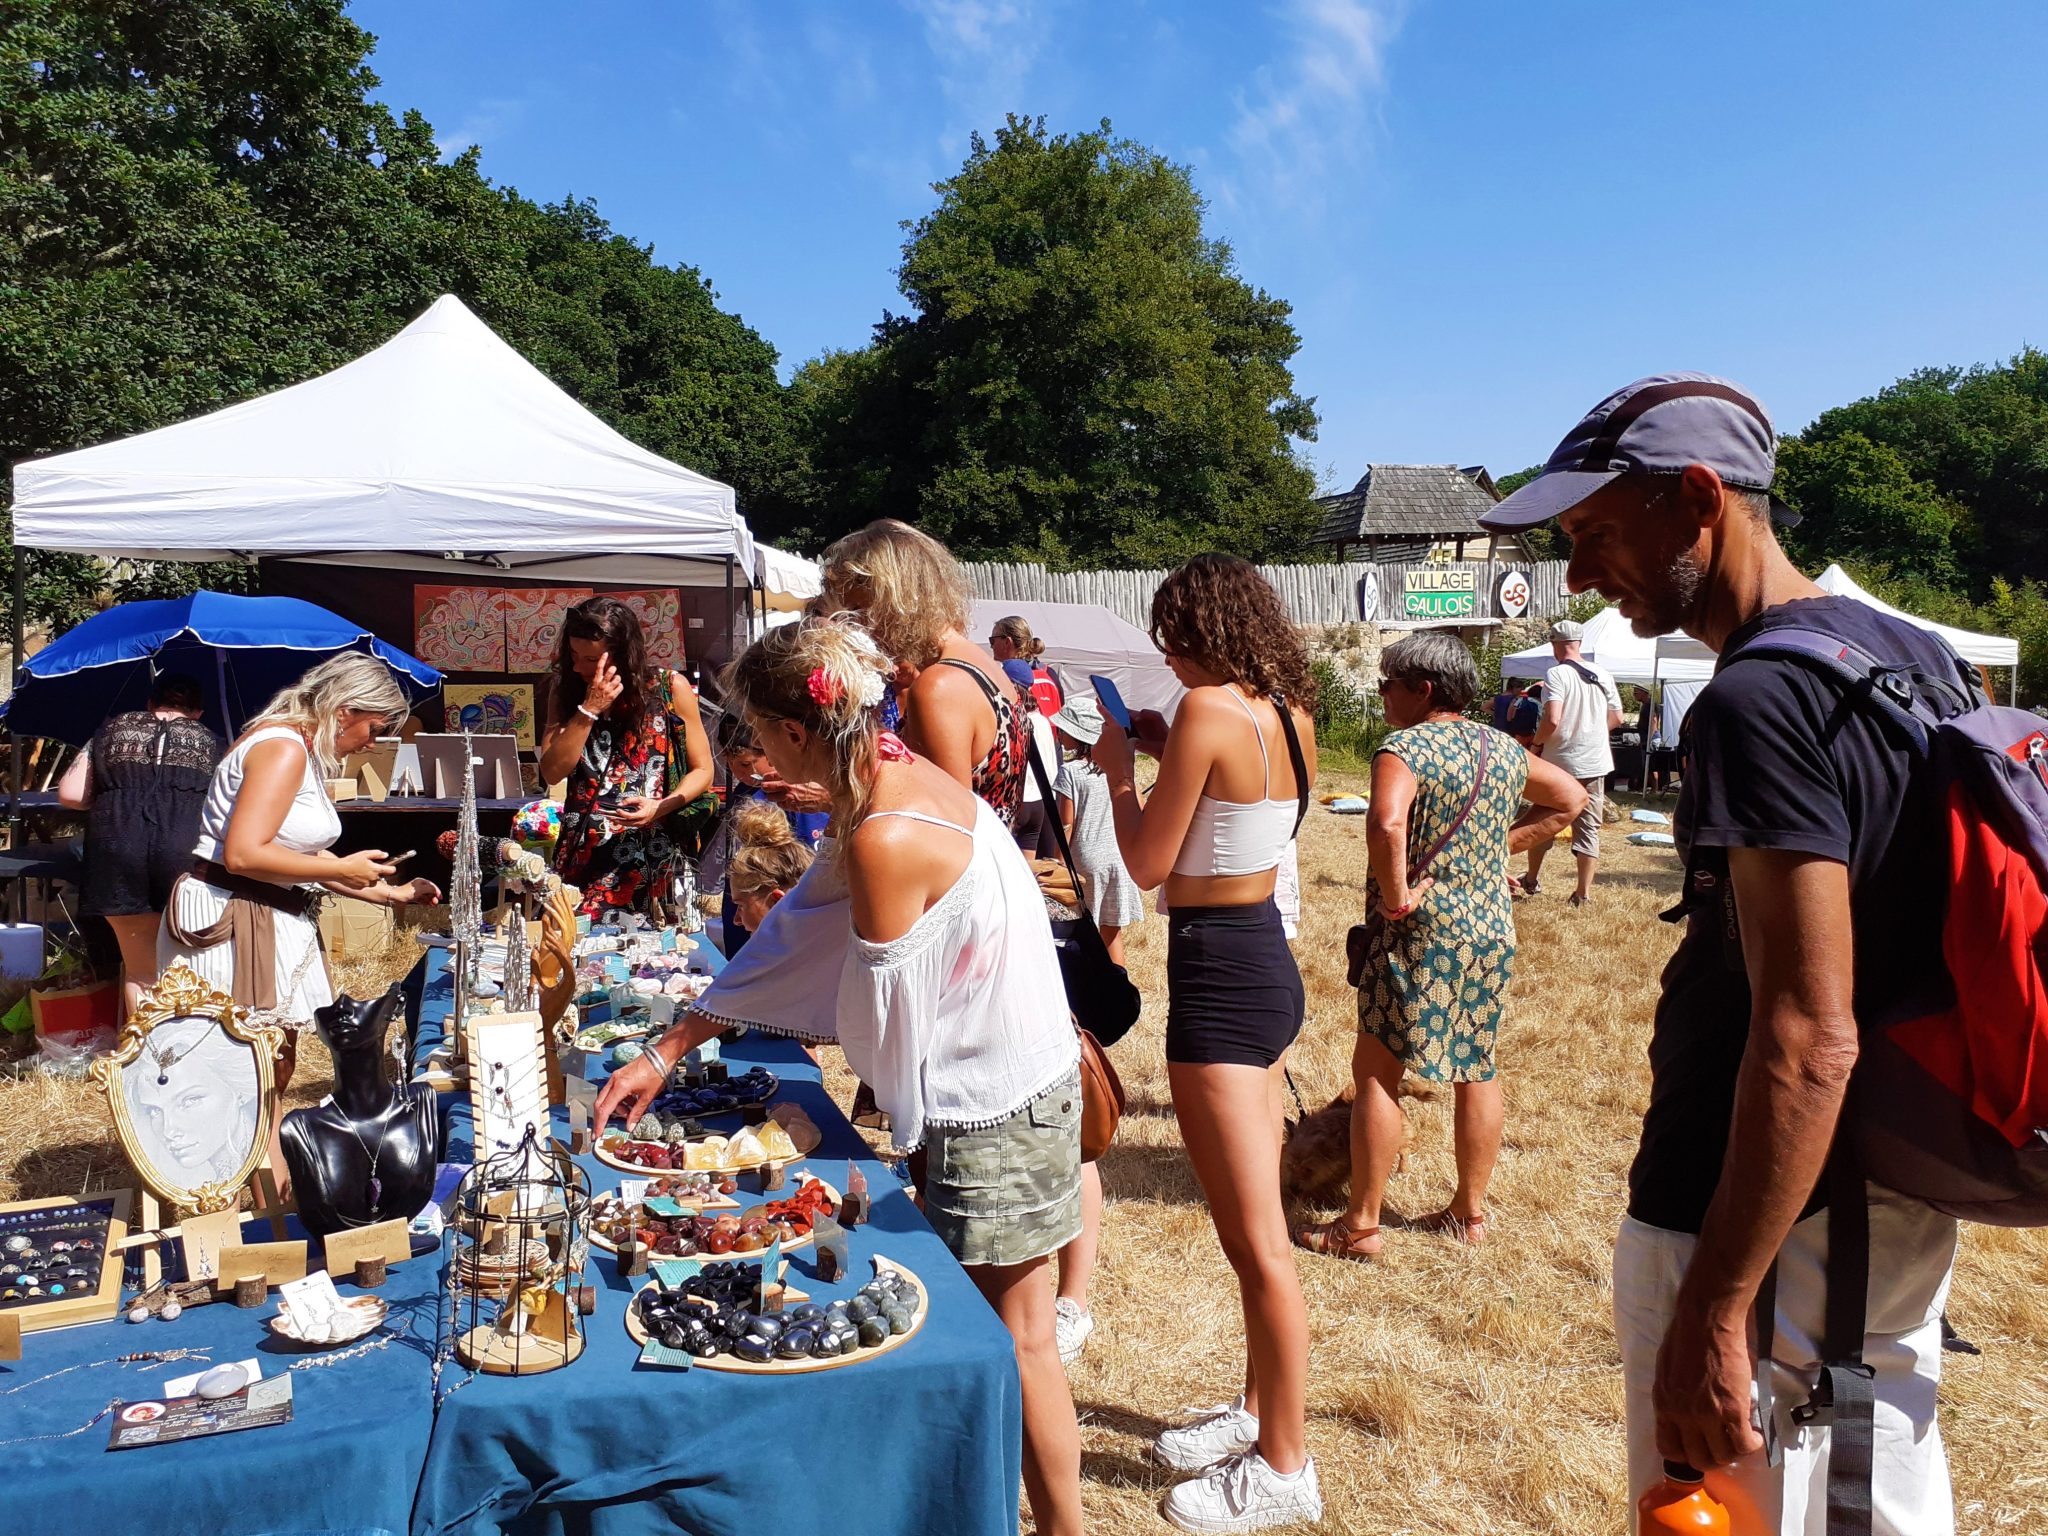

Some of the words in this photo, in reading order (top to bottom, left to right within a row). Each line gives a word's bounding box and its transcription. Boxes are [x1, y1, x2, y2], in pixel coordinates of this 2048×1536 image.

[1433, 550, 1450, 563] LE
[1408, 572, 1472, 590] VILLAGE
[1406, 595, 1473, 615] GAULOIS
[1724, 877, 1737, 939] Quechua
